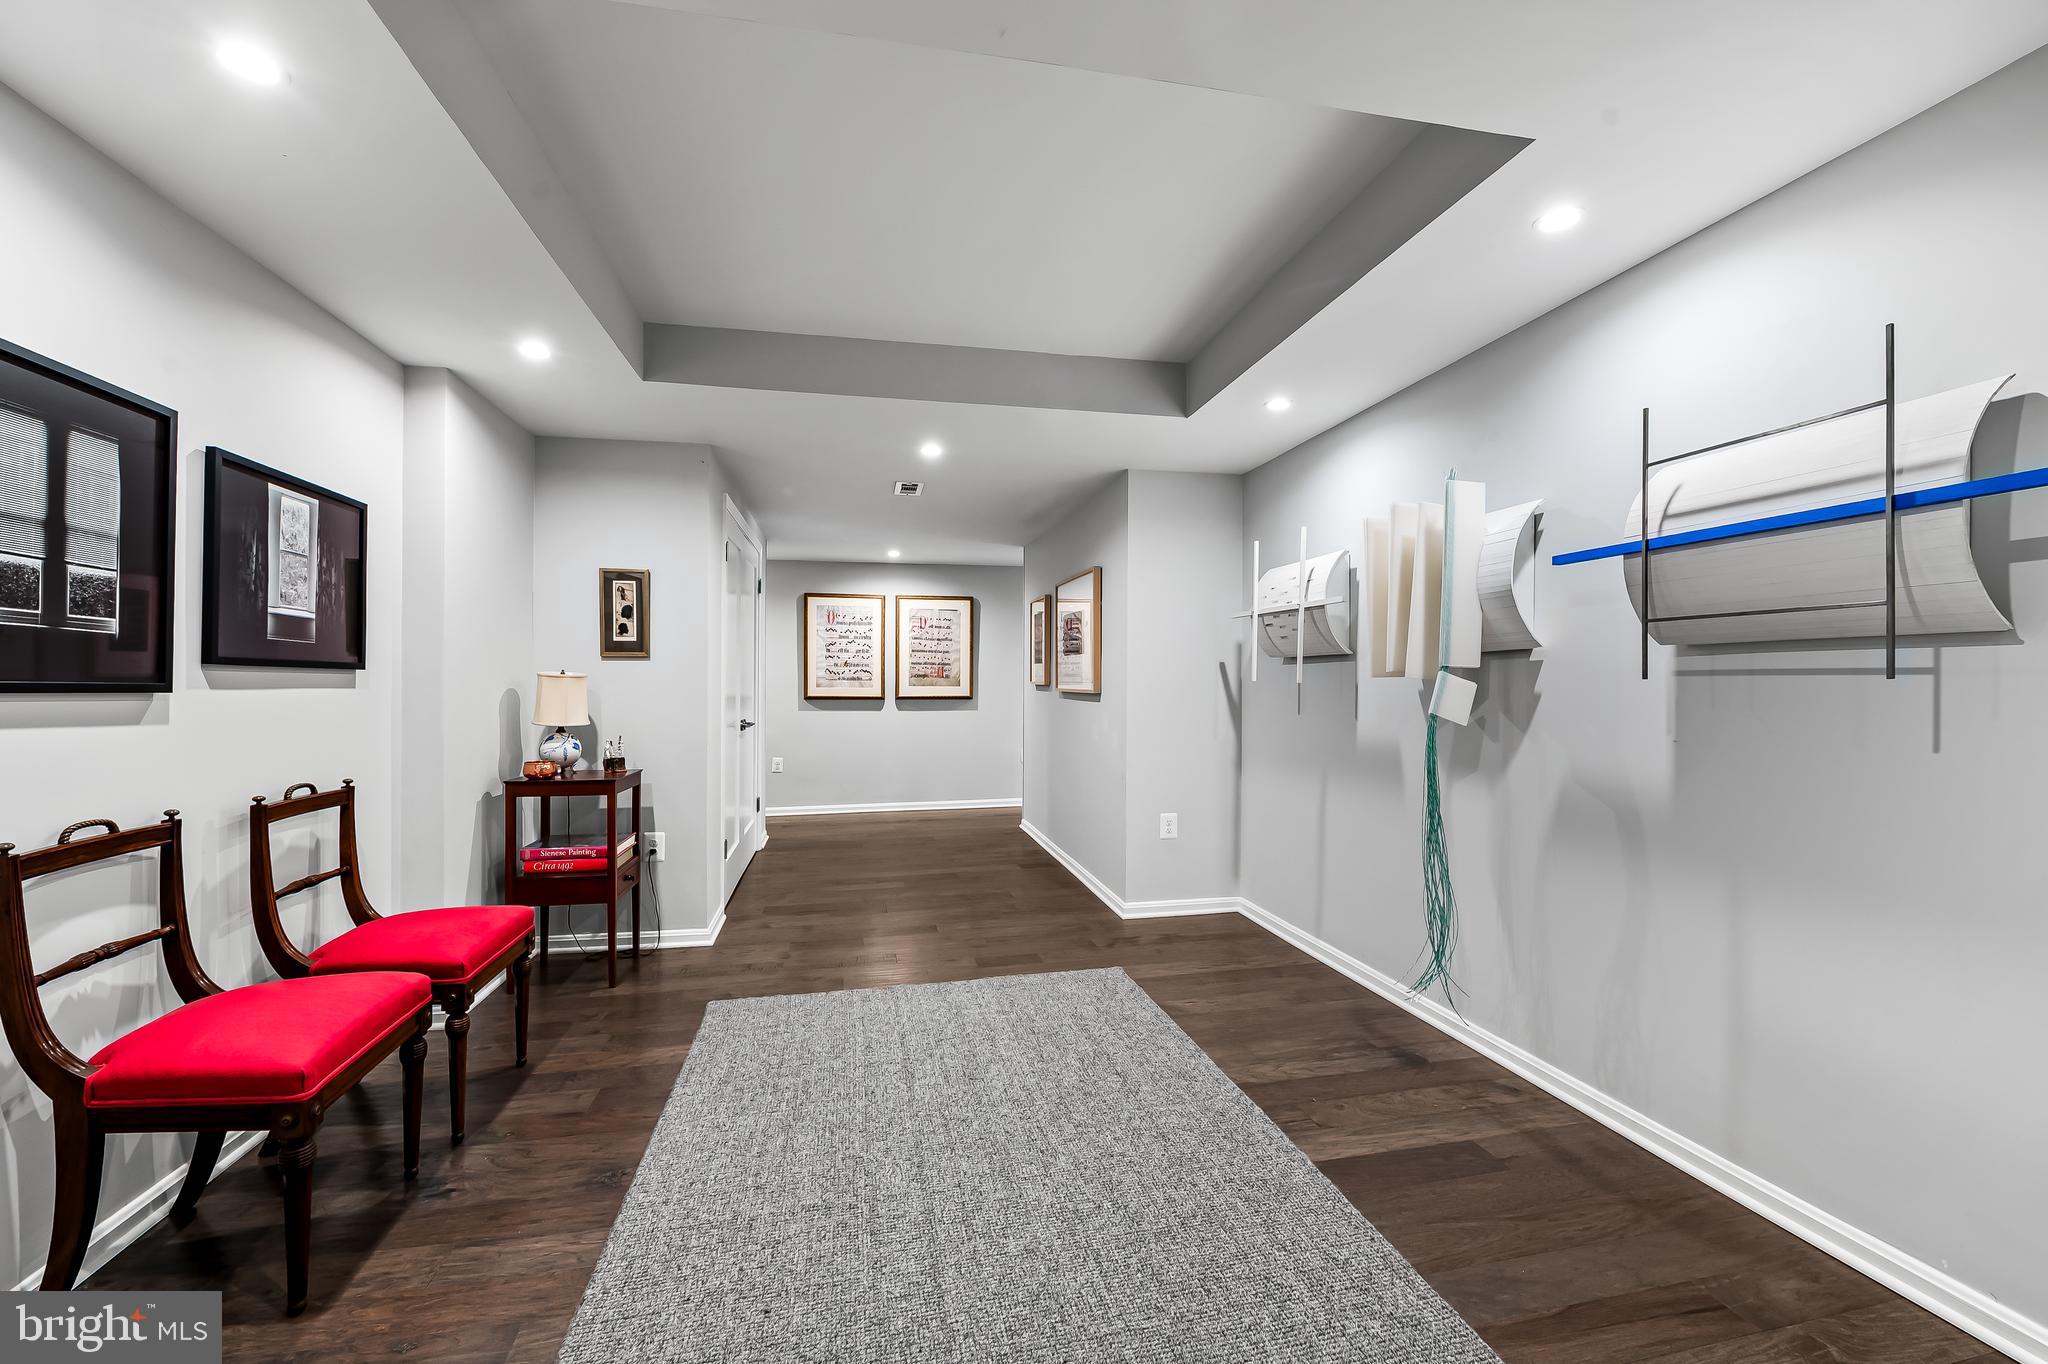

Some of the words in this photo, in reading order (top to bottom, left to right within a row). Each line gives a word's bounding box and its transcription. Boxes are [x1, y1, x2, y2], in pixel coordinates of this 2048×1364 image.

[540, 849, 567, 857] Sienese
[568, 848, 597, 857] Painting
[533, 861, 556, 871] Circa
[557, 862, 574, 872] 1492
